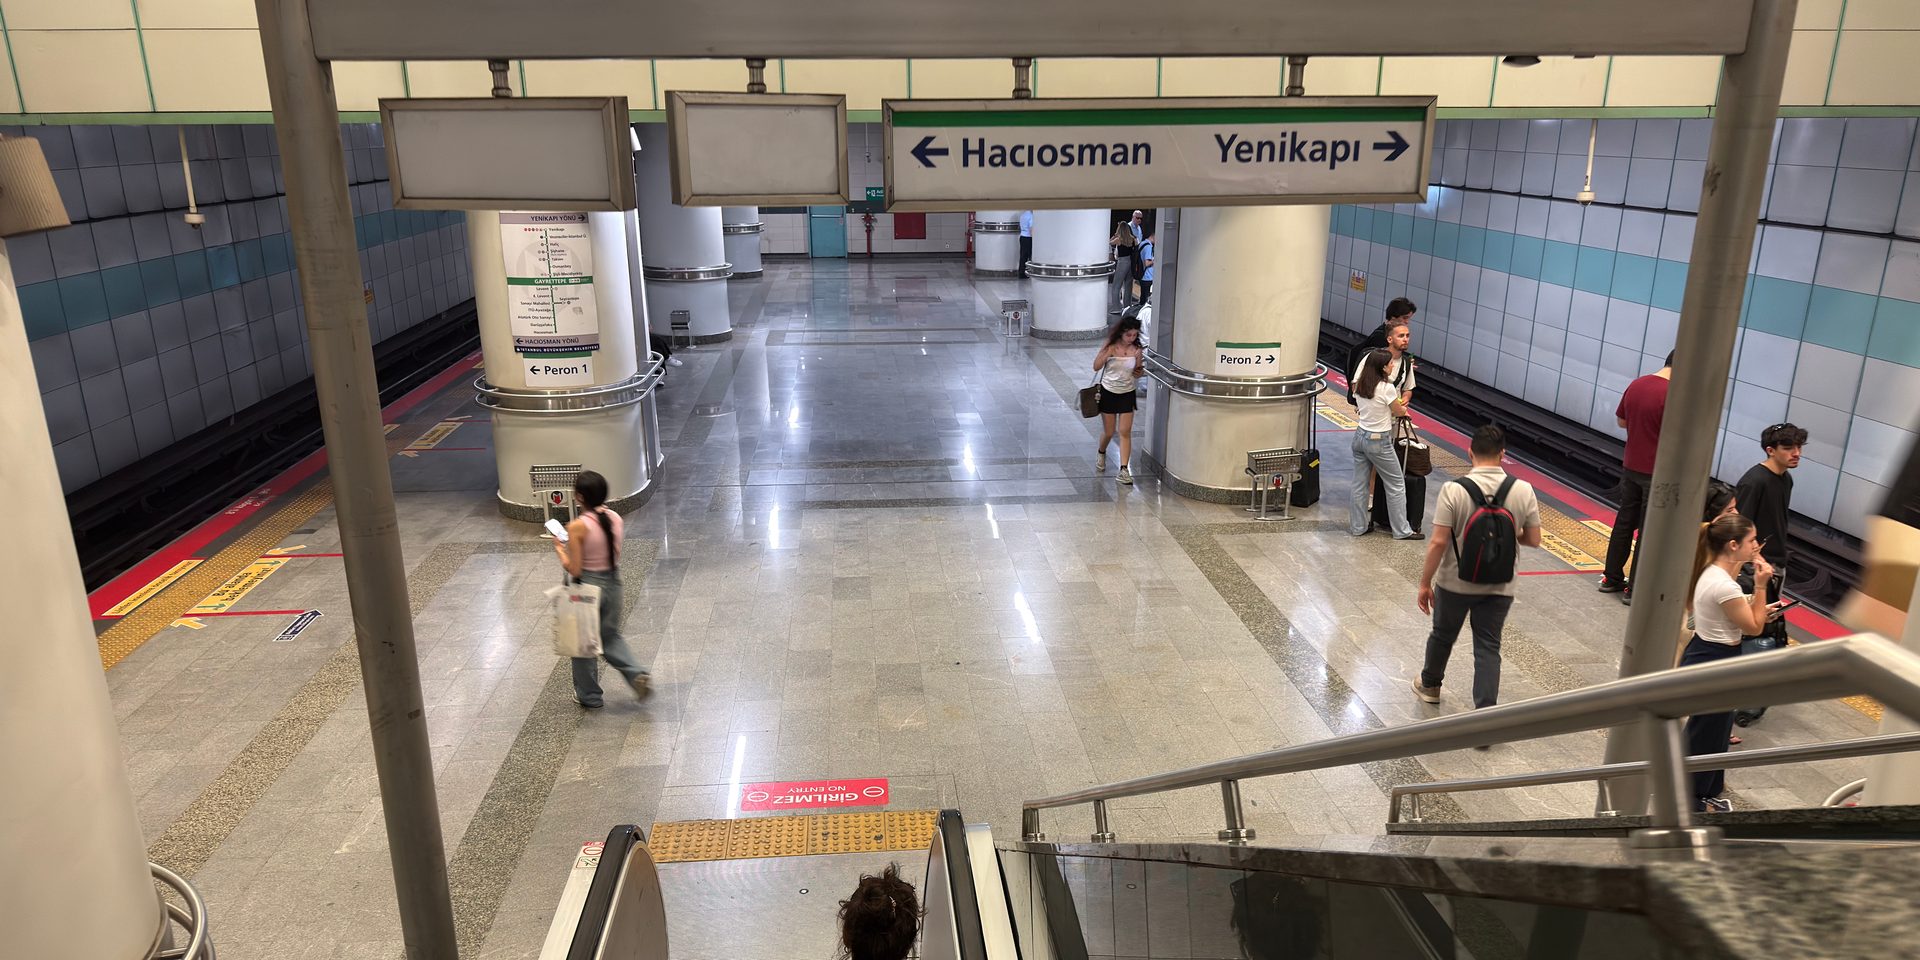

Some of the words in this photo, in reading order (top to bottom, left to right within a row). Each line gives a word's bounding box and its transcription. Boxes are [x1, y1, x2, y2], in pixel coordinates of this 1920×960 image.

[962, 137, 1152, 168] Hacıosman
[1214, 131, 1361, 170] Yenikapı
[1220, 354, 1251, 364] Peron
[1255, 355, 1261, 364] 2
[544, 365, 578, 375] Peron
[582, 363, 588, 373] 1
[211, 589, 230, 597] Bu
[224, 572, 252, 589] alanda
[773, 792, 859, 804] GİRİLMEZ
